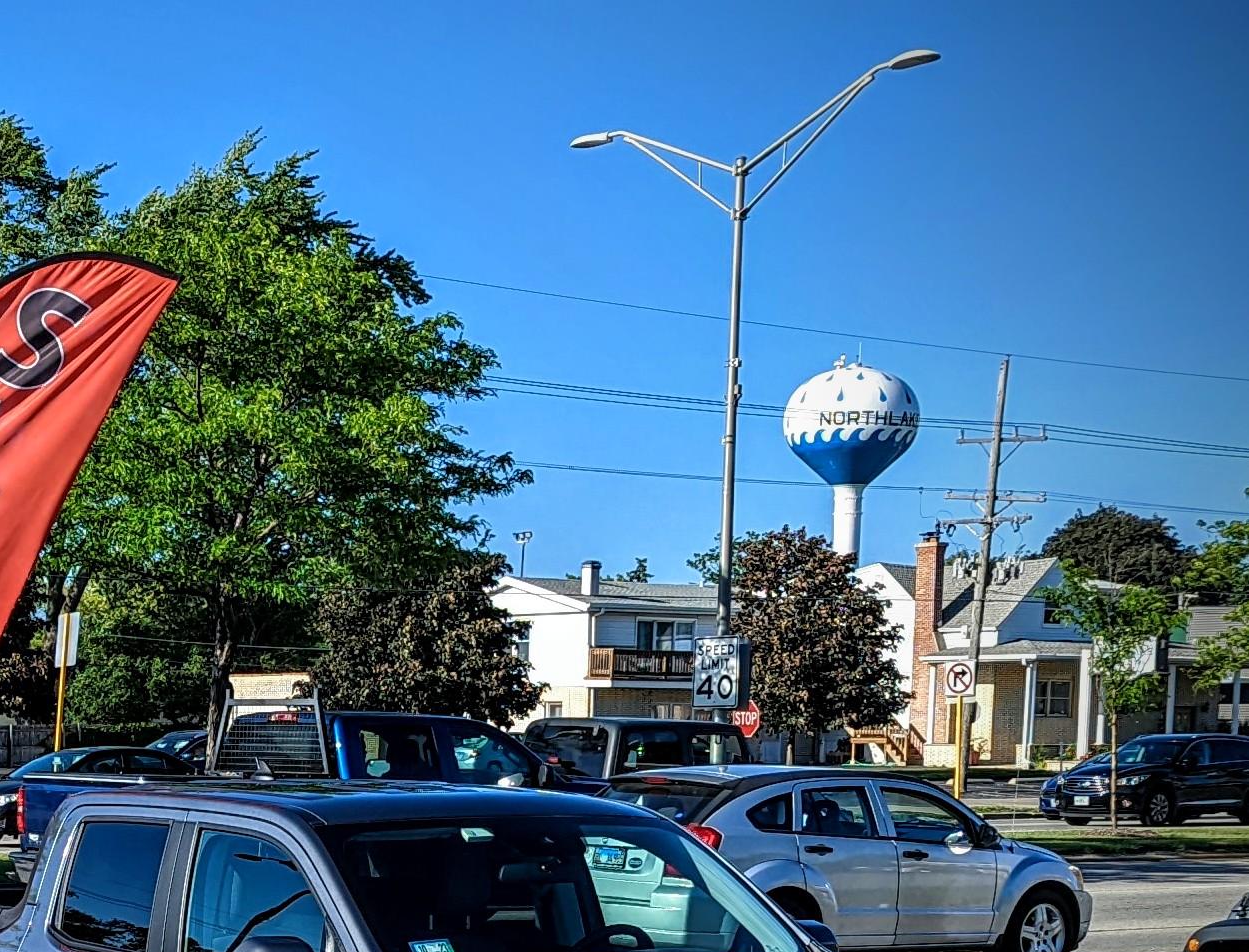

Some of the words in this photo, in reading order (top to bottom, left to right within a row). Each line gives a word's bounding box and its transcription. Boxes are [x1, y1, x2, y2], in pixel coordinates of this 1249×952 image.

[697, 644, 735, 656] SPEED
[701, 658, 730, 670] LIMIT
[696, 674, 733, 700] 40
[734, 711, 757, 725] STOP
